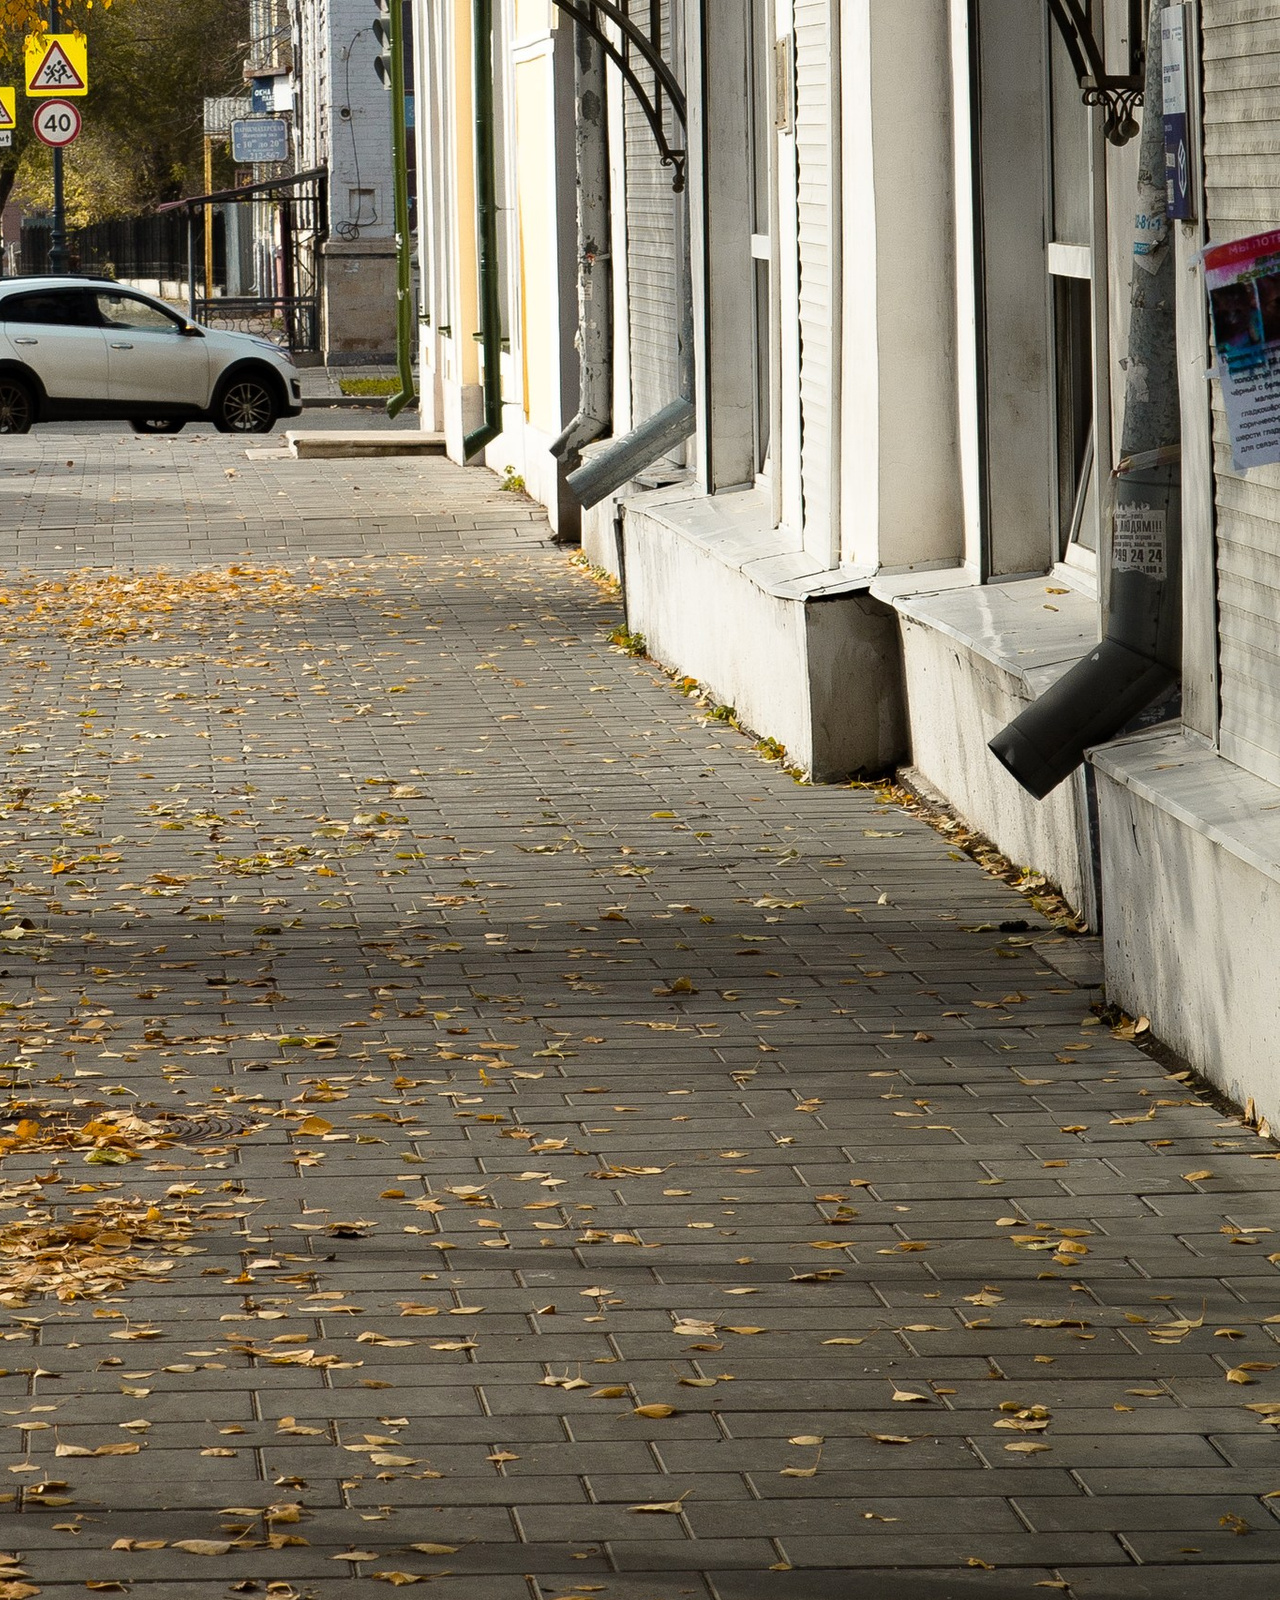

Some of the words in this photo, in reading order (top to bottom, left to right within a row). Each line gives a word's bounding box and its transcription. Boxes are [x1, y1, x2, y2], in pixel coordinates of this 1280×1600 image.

[44, 113, 71, 132] 40
[1130, 549, 1145, 563] 24
[1148, 549, 1163, 563] 24
